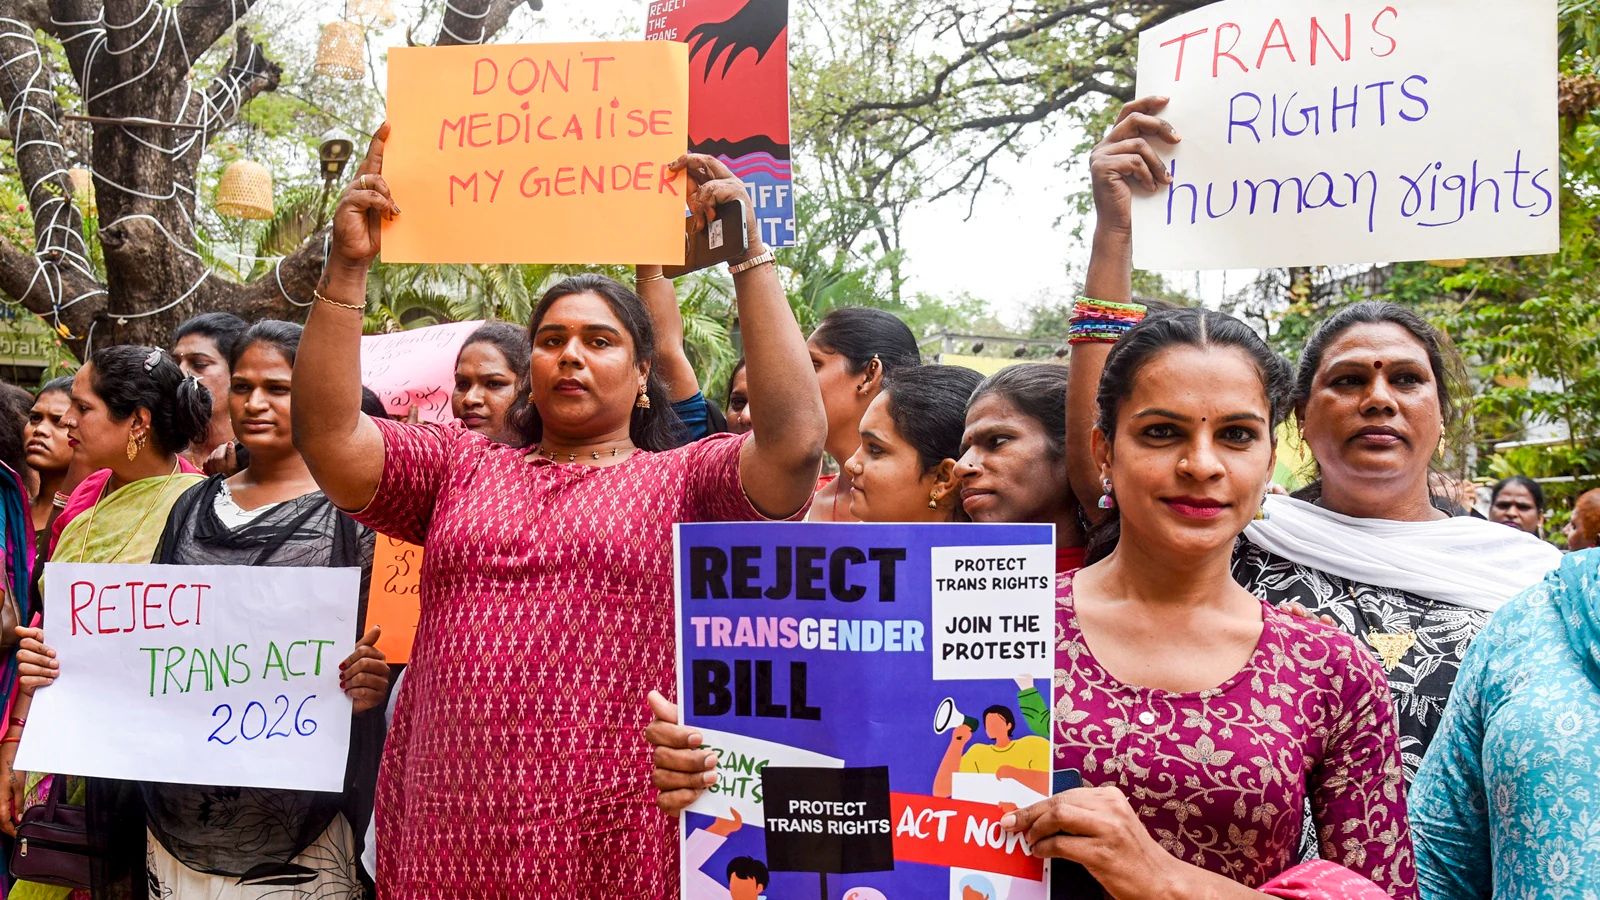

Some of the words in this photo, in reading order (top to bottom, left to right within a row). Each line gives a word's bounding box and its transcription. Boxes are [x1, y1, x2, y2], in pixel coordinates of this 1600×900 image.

[649, 16, 667, 31] THE
[1160, 6, 1398, 81] TRANS
[473, 51, 615, 96] DON'T
[1228, 75, 1429, 144] RIGHTS
[449, 169, 504, 207] MY
[520, 162, 680, 198] GENDER
[1166, 158, 1377, 232] human
[1400, 150, 1553, 227] rights
[689, 545, 906, 602] REJECT
[936, 577, 990, 591] TRANS
[992, 576, 1048, 590] RIGHTS
[954, 557, 1026, 572] PROTECT
[71, 581, 211, 636] REJECT
[944, 615, 991, 634] JOIN
[999, 615, 1040, 632] THE
[690, 616, 925, 652] TRANSGENDER
[942, 641, 1046, 660] PROTEST!
[140, 642, 251, 697] TRANS
[262, 640, 335, 681] ACT
[692, 659, 821, 721] BILL
[208, 694, 317, 745] 2026
[697, 744, 769, 779] RANS
[767, 818, 823, 833] TRANS
[827, 819, 890, 835] RIGHTS
[789, 801, 866, 817] PROTECT
[896, 806, 957, 843] ACT
